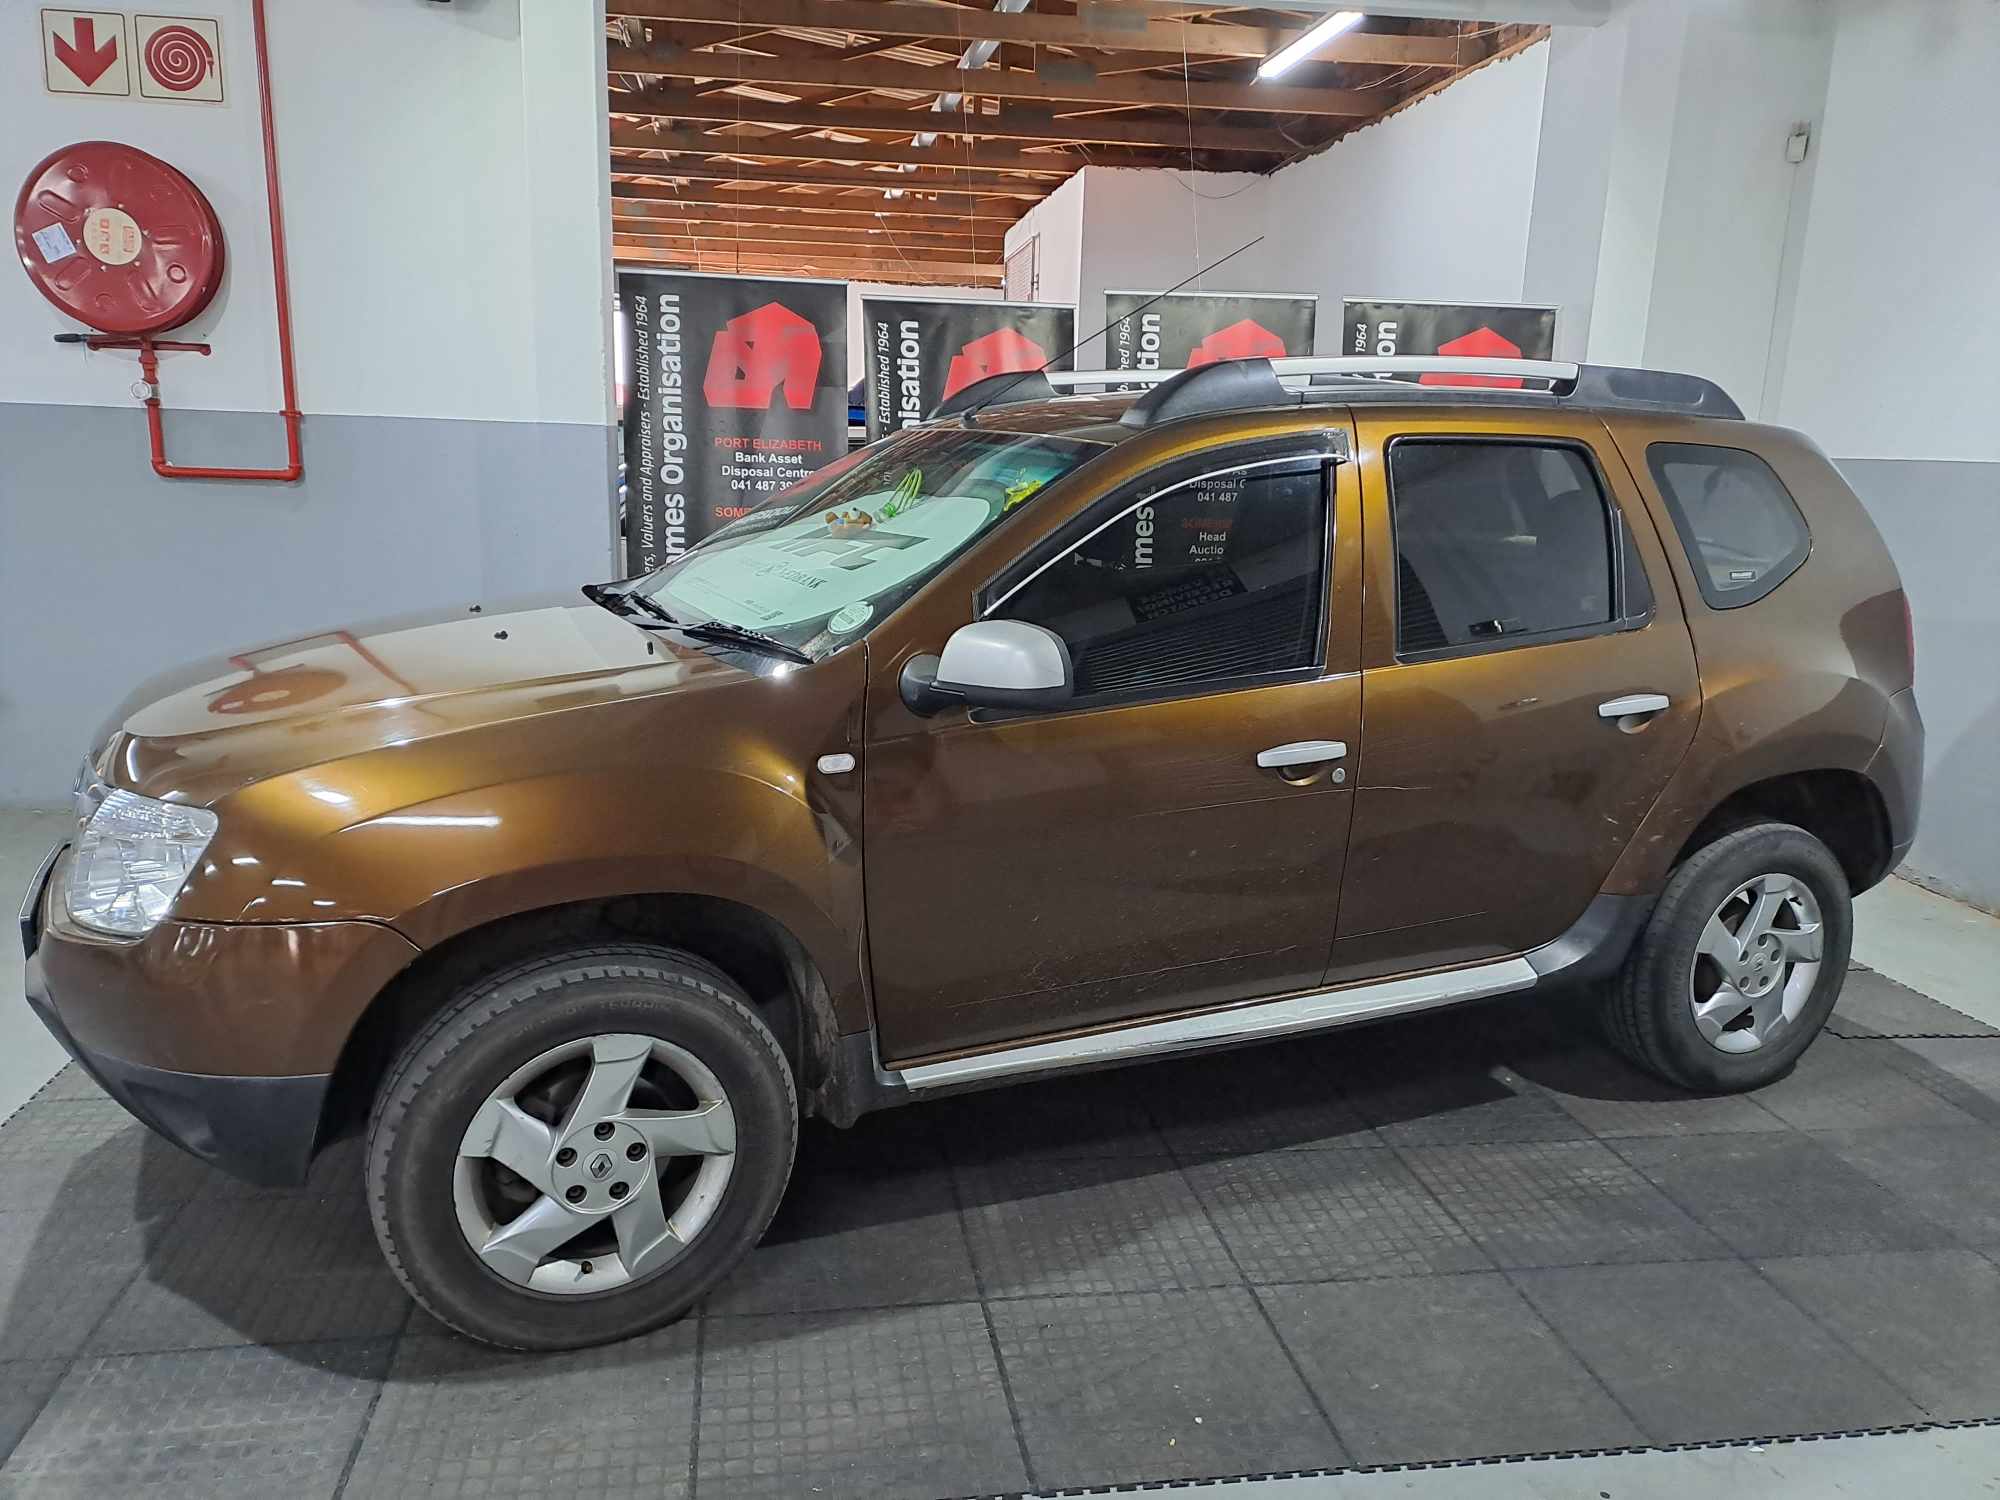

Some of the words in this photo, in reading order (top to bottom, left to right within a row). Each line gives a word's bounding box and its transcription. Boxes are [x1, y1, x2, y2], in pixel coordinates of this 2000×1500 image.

[634, 295, 648, 326] 1964
[877, 322, 889, 353] 1964
[1355, 324, 1367, 352] 1964
[1377, 322, 1397, 355] on
[634, 328, 650, 401] Established
[656, 294, 687, 485] Organisation
[877, 355, 890, 424] Established
[639, 409, 655, 476] Appraisers
[714, 437, 749, 448] PORT
[752, 439, 822, 450] ELIZABETH
[735, 452, 766, 463] Bank
[768, 454, 803, 464] Asset
[721, 465, 773, 478] Disposal
[731, 480, 751, 490] 041
[755, 480, 775, 491] 487
[639, 477, 653, 500] and
[1197, 493, 1215, 502] 041
[1219, 493, 1238, 502] 487
[640, 504, 654, 548] Valuers
[1136, 506, 1154, 568] mes
[1199, 531, 1226, 541] Head
